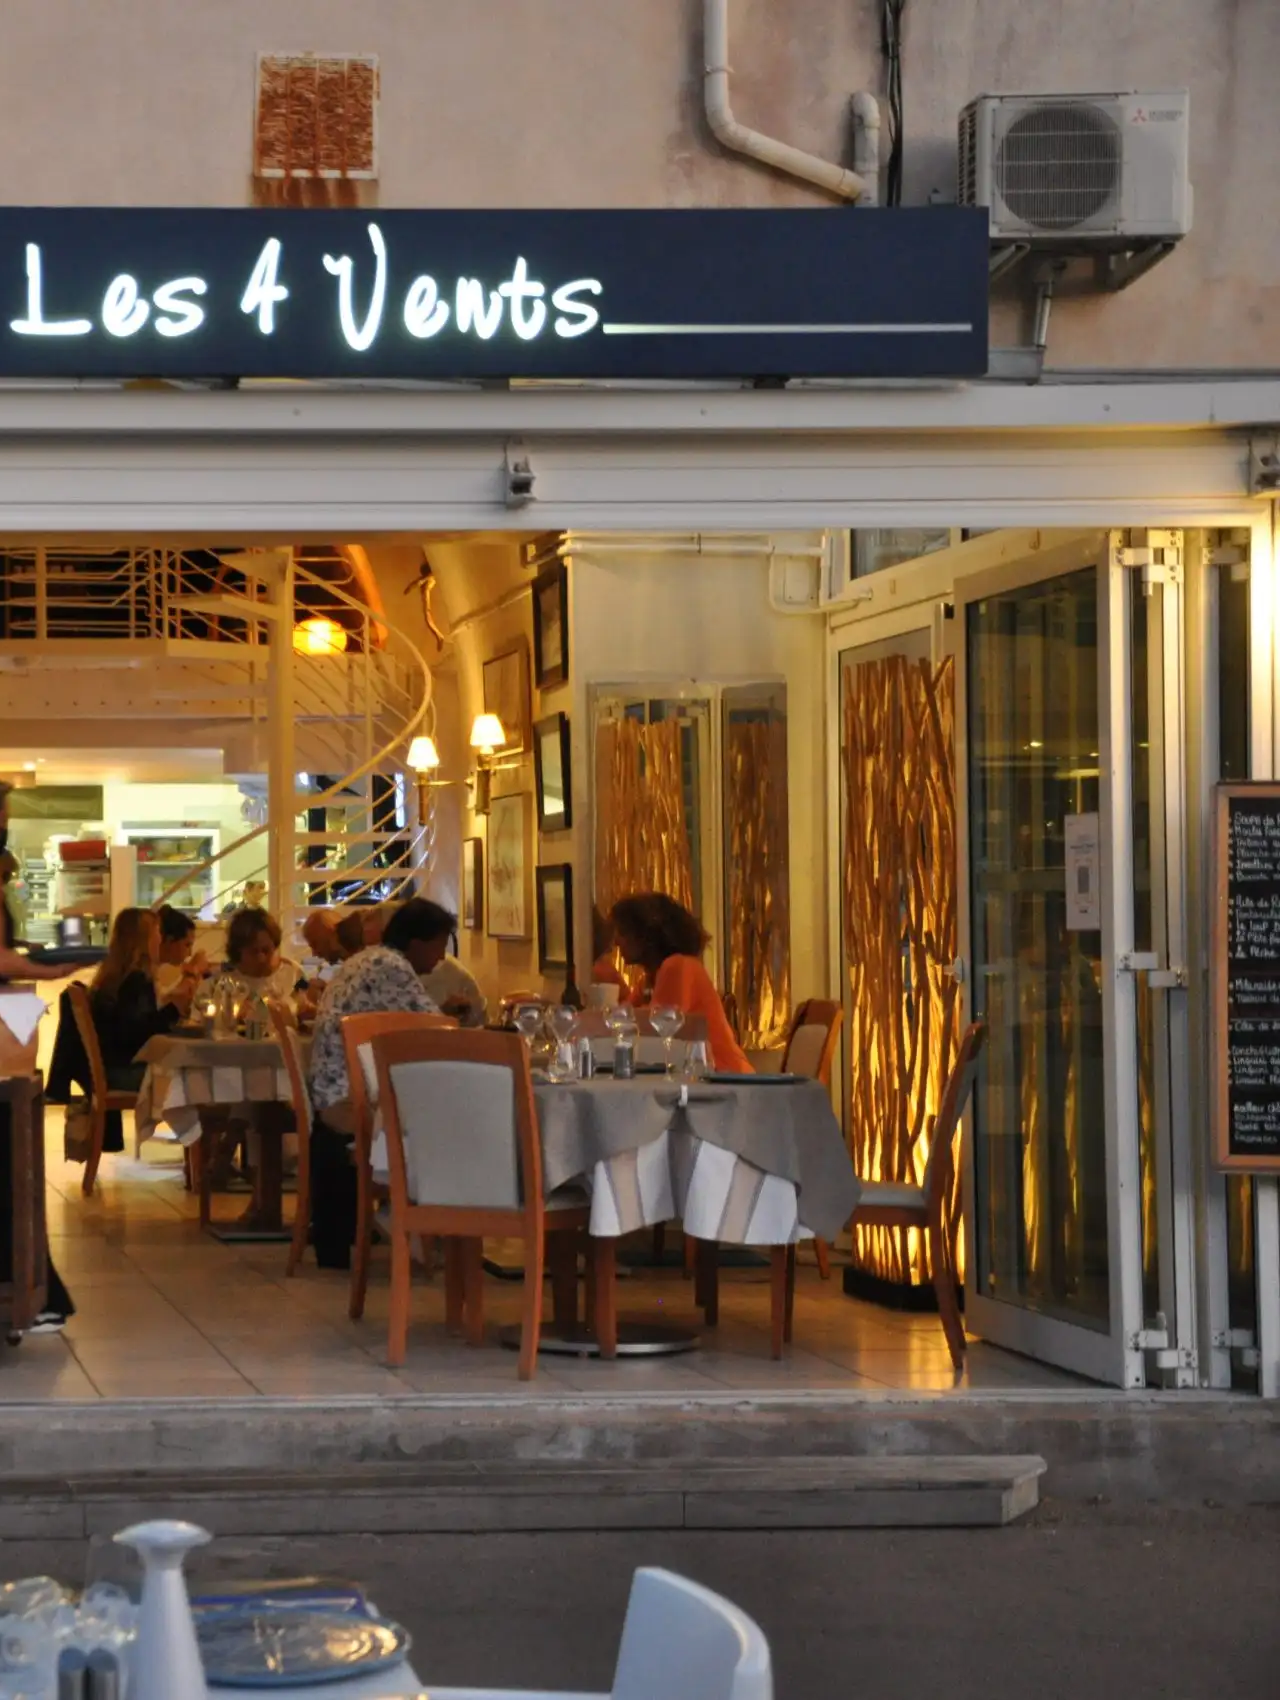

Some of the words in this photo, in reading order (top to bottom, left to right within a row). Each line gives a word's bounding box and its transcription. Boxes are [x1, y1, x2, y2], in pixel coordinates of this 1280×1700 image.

[10, 243, 207, 337] Les
[240, 237, 288, 334] 4
[322, 222, 603, 351] Vents
